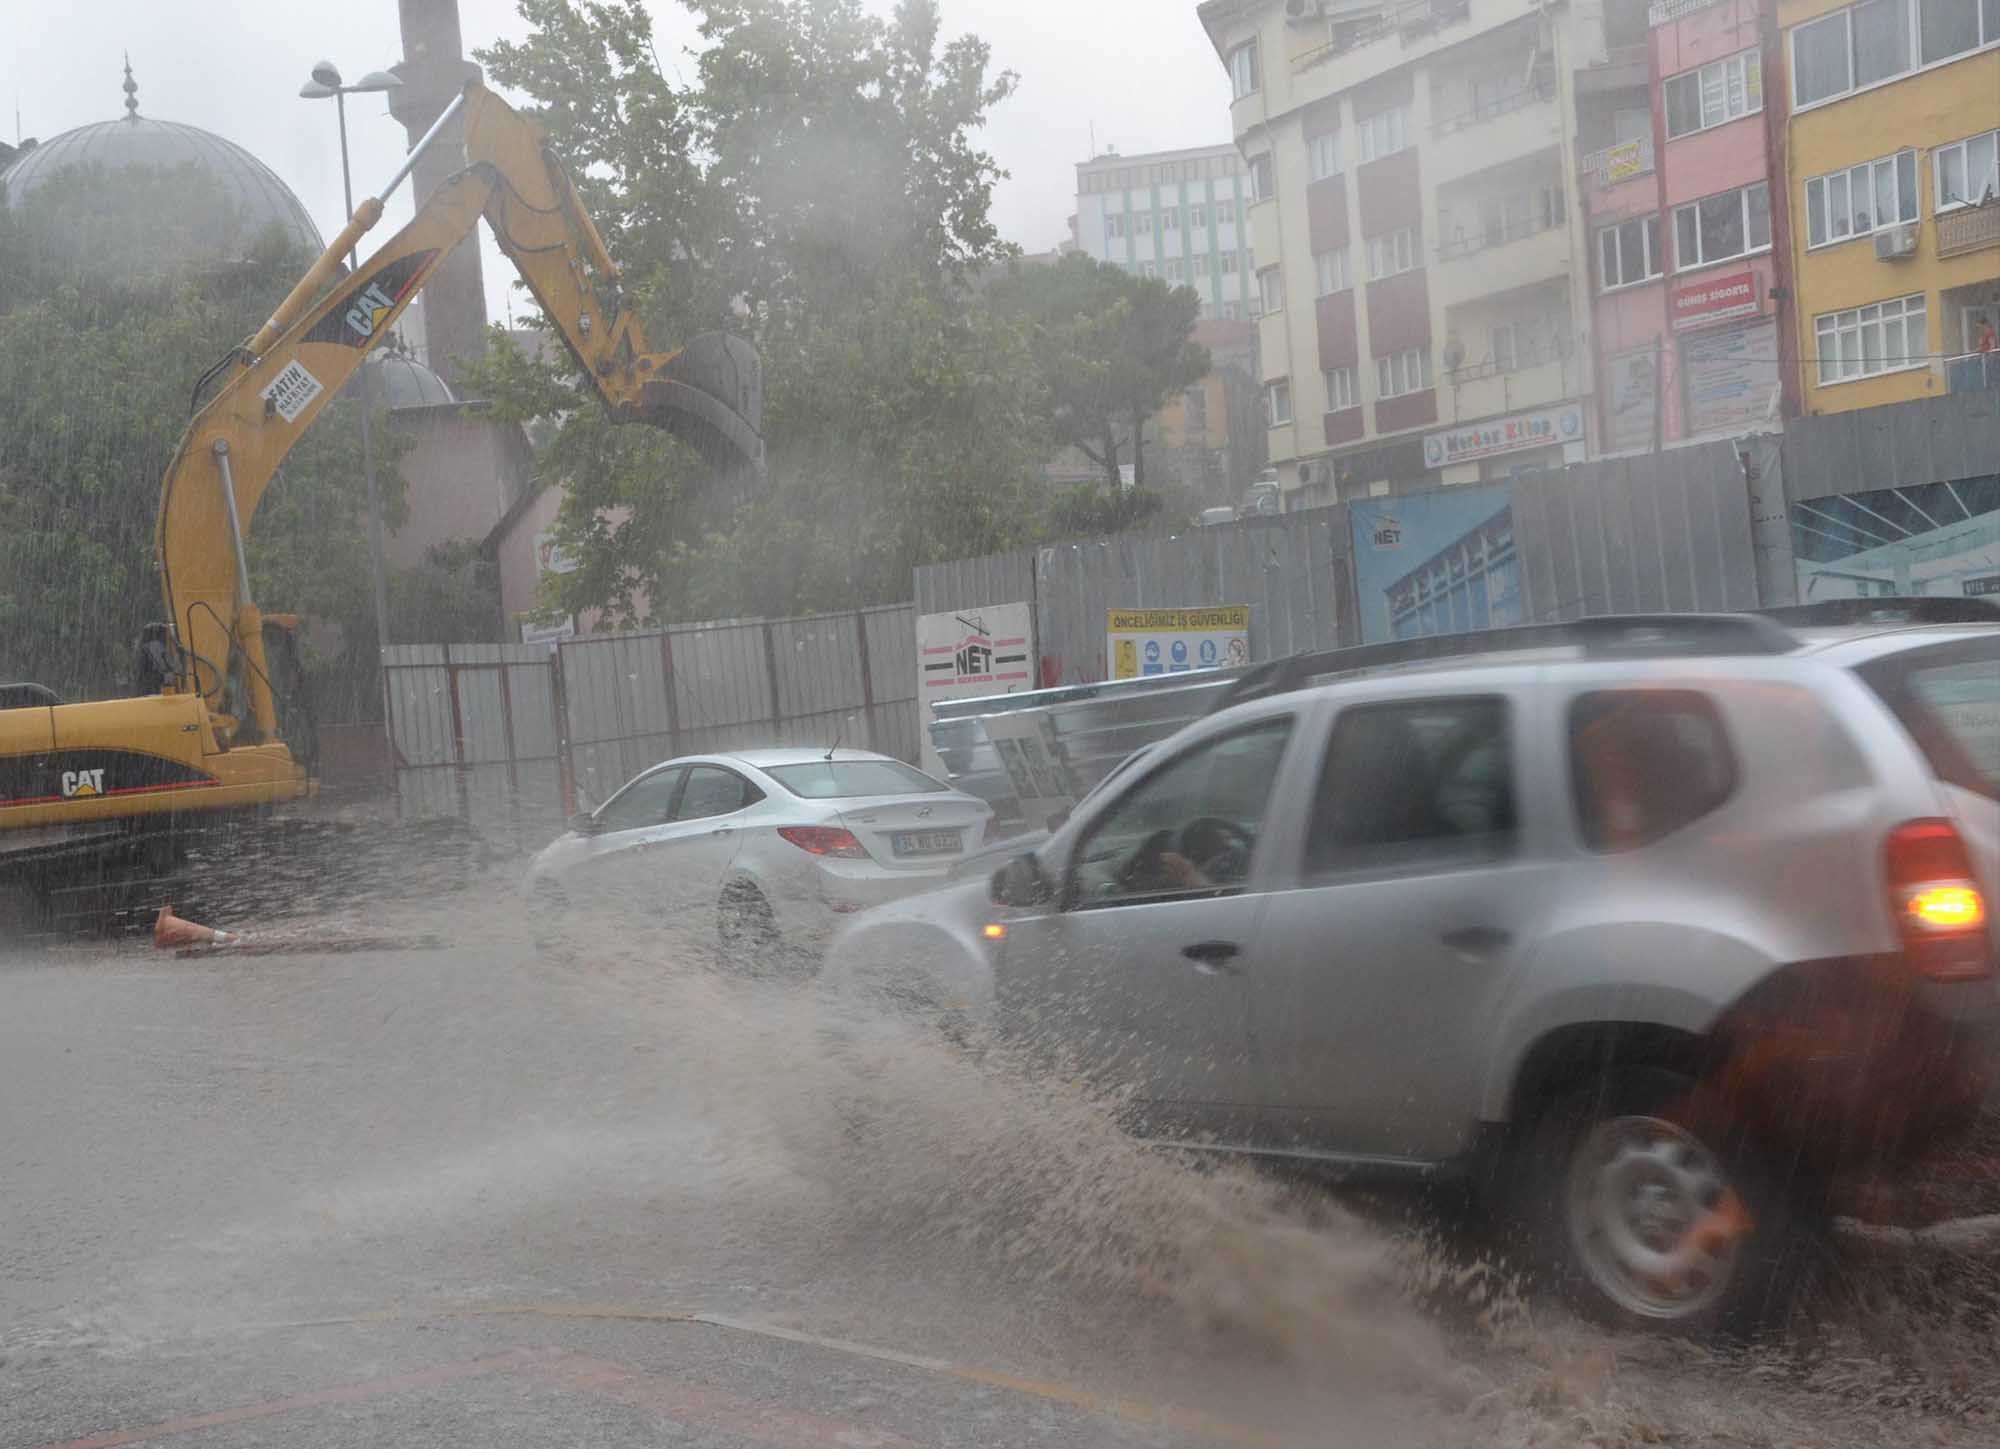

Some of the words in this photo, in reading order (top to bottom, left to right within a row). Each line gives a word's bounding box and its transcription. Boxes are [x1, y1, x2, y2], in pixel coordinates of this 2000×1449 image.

[345, 281, 396, 337] CAT
[267, 366, 303, 403] FATİH
[1373, 529, 1401, 545] NET
[956, 645, 992, 675] NET
[62, 768, 104, 797] CAT
